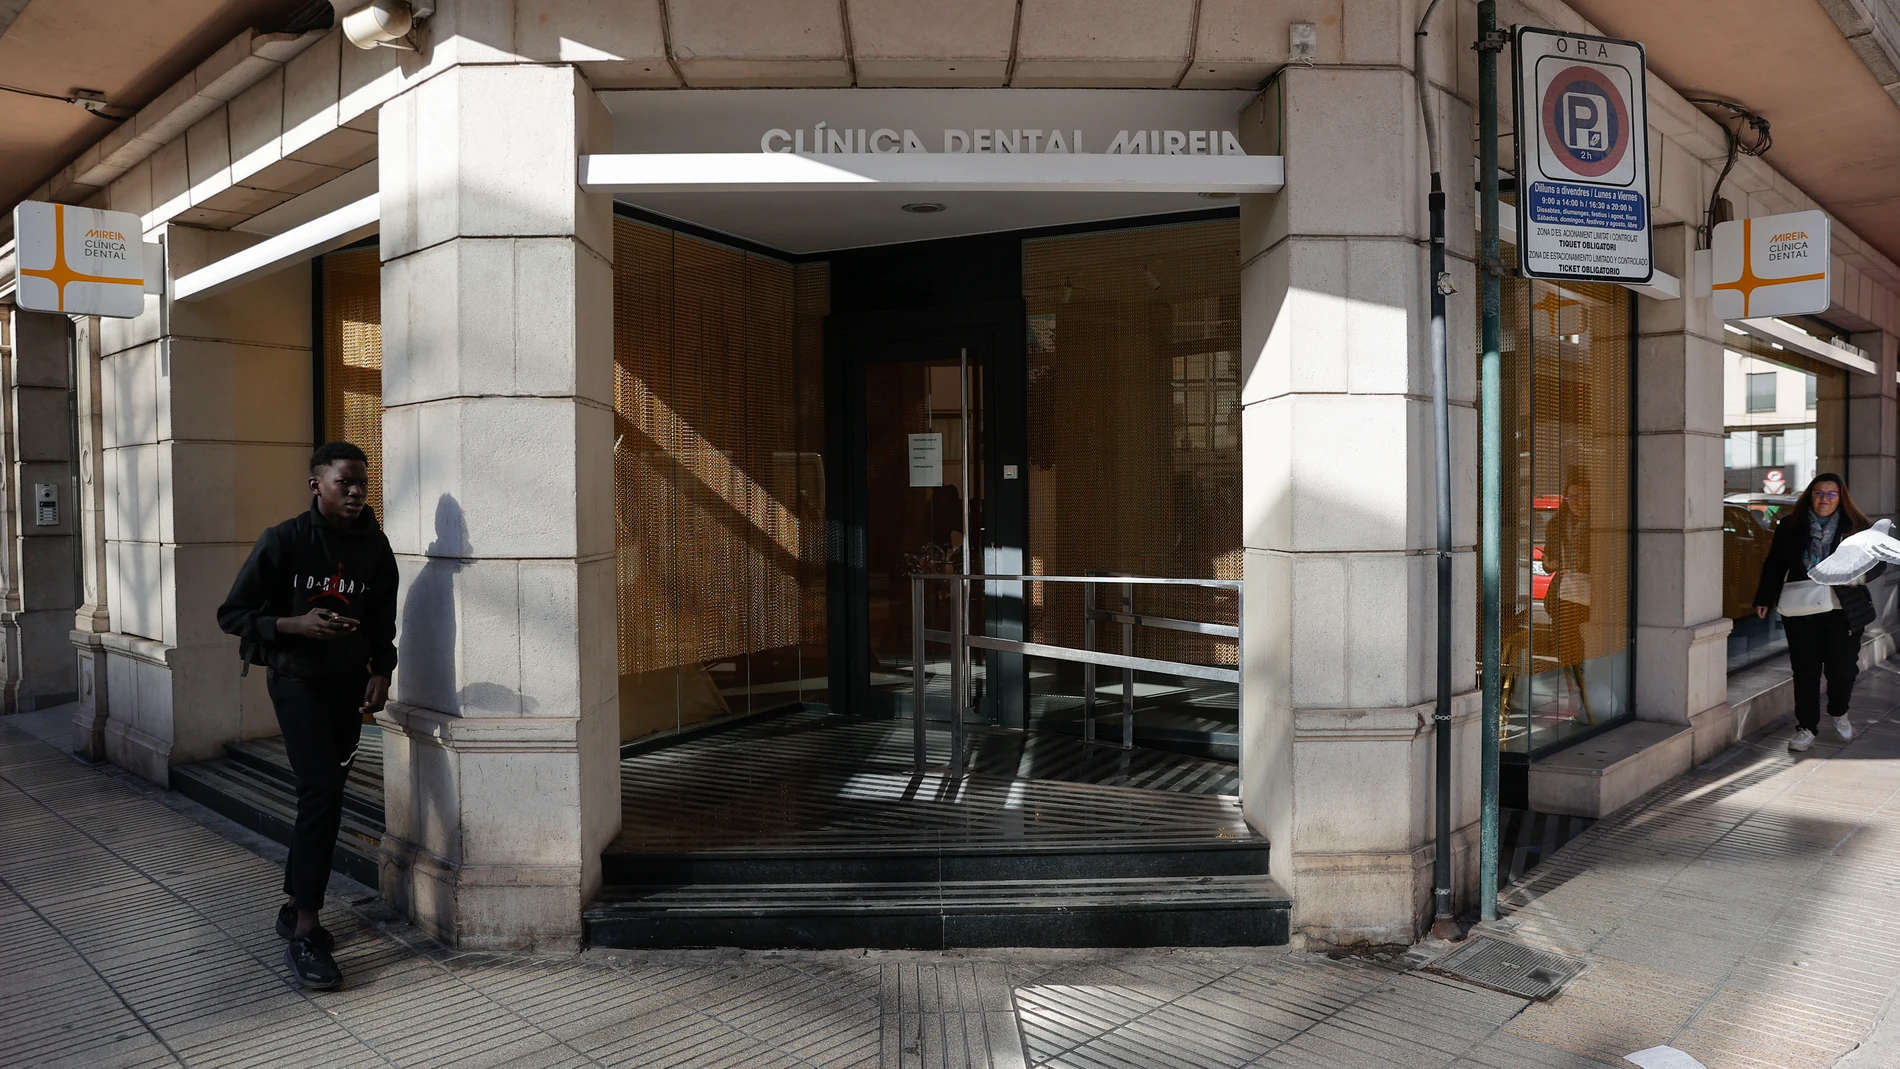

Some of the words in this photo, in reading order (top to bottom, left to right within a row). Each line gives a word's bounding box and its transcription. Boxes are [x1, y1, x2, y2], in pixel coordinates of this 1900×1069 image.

[1556, 38, 1608, 58] ORA
[1567, 95, 1599, 147] P
[760, 120, 930, 154] CLÍNICA
[944, 128, 1090, 154] DENTAL
[1105, 129, 1249, 156] MIREIA
[1534, 182, 1556, 194] Dilluns
[1556, 187, 1560, 195] a
[1561, 185, 1590, 198] divendres
[1594, 189, 1612, 199] Lunes
[1612, 192, 1617, 200] a
[1617, 190, 1638, 202] Viernes
[1541, 196, 1556, 205] 9:00
[1562, 198, 1579, 207] 14:00
[1580, 199, 1584, 207] h
[1589, 201, 1606, 210] 16:30
[1611, 202, 1628, 212] 20:00
[1628, 204, 1633, 212] h
[84, 228, 126, 241] MIREIA
[1536, 227, 1550, 236] ZONA
[1593, 231, 1610, 241] LIMITAT
[1612, 233, 1638, 243] CONTROLAT
[1769, 231, 1809, 243] MIREIA
[84, 239, 126, 251] CLÍNICA
[1558, 239, 1581, 249] TIQUET
[1582, 241, 1617, 251] OBLIGATORI
[1769, 241, 1809, 253] CLÍNICA
[84, 248, 126, 260] DENTAL
[1528, 250, 1542, 259] ZONA
[1542, 251, 1550, 260] DE
[1550, 251, 1593, 262] ESTACIONAMIENTO
[1593, 254, 1614, 264] LIMITADO
[1613, 255, 1618, 264] Y
[1617, 256, 1649, 266] CONTROLADO
[1768, 250, 1808, 261] DENTAL
[1558, 263, 1581, 273] TICKET
[1581, 265, 1620, 276] OBLIGATORIO
